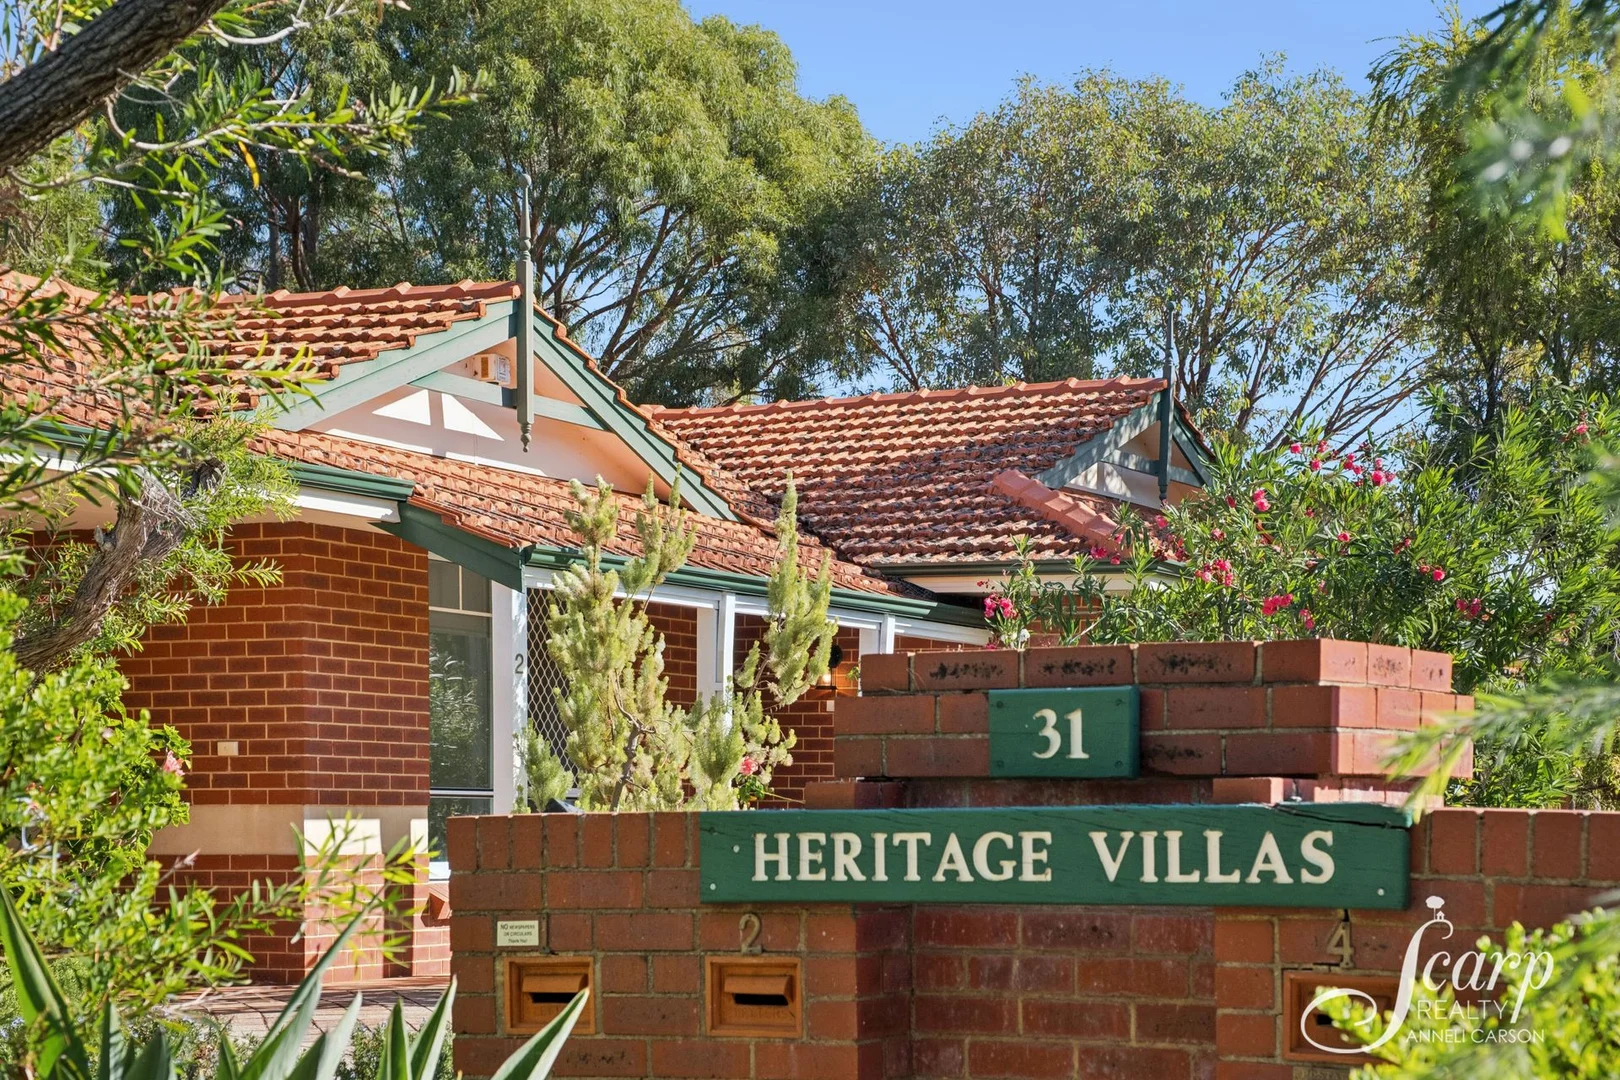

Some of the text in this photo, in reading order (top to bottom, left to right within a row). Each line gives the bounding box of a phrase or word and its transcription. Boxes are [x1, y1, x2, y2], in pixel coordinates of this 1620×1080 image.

[514, 653, 524, 674] 2
[1032, 708, 1090, 759] 31
[752, 830, 1336, 884] HERITAGE VILLAS
[738, 913, 762, 954] 2
[1326, 921, 1355, 968] 4
